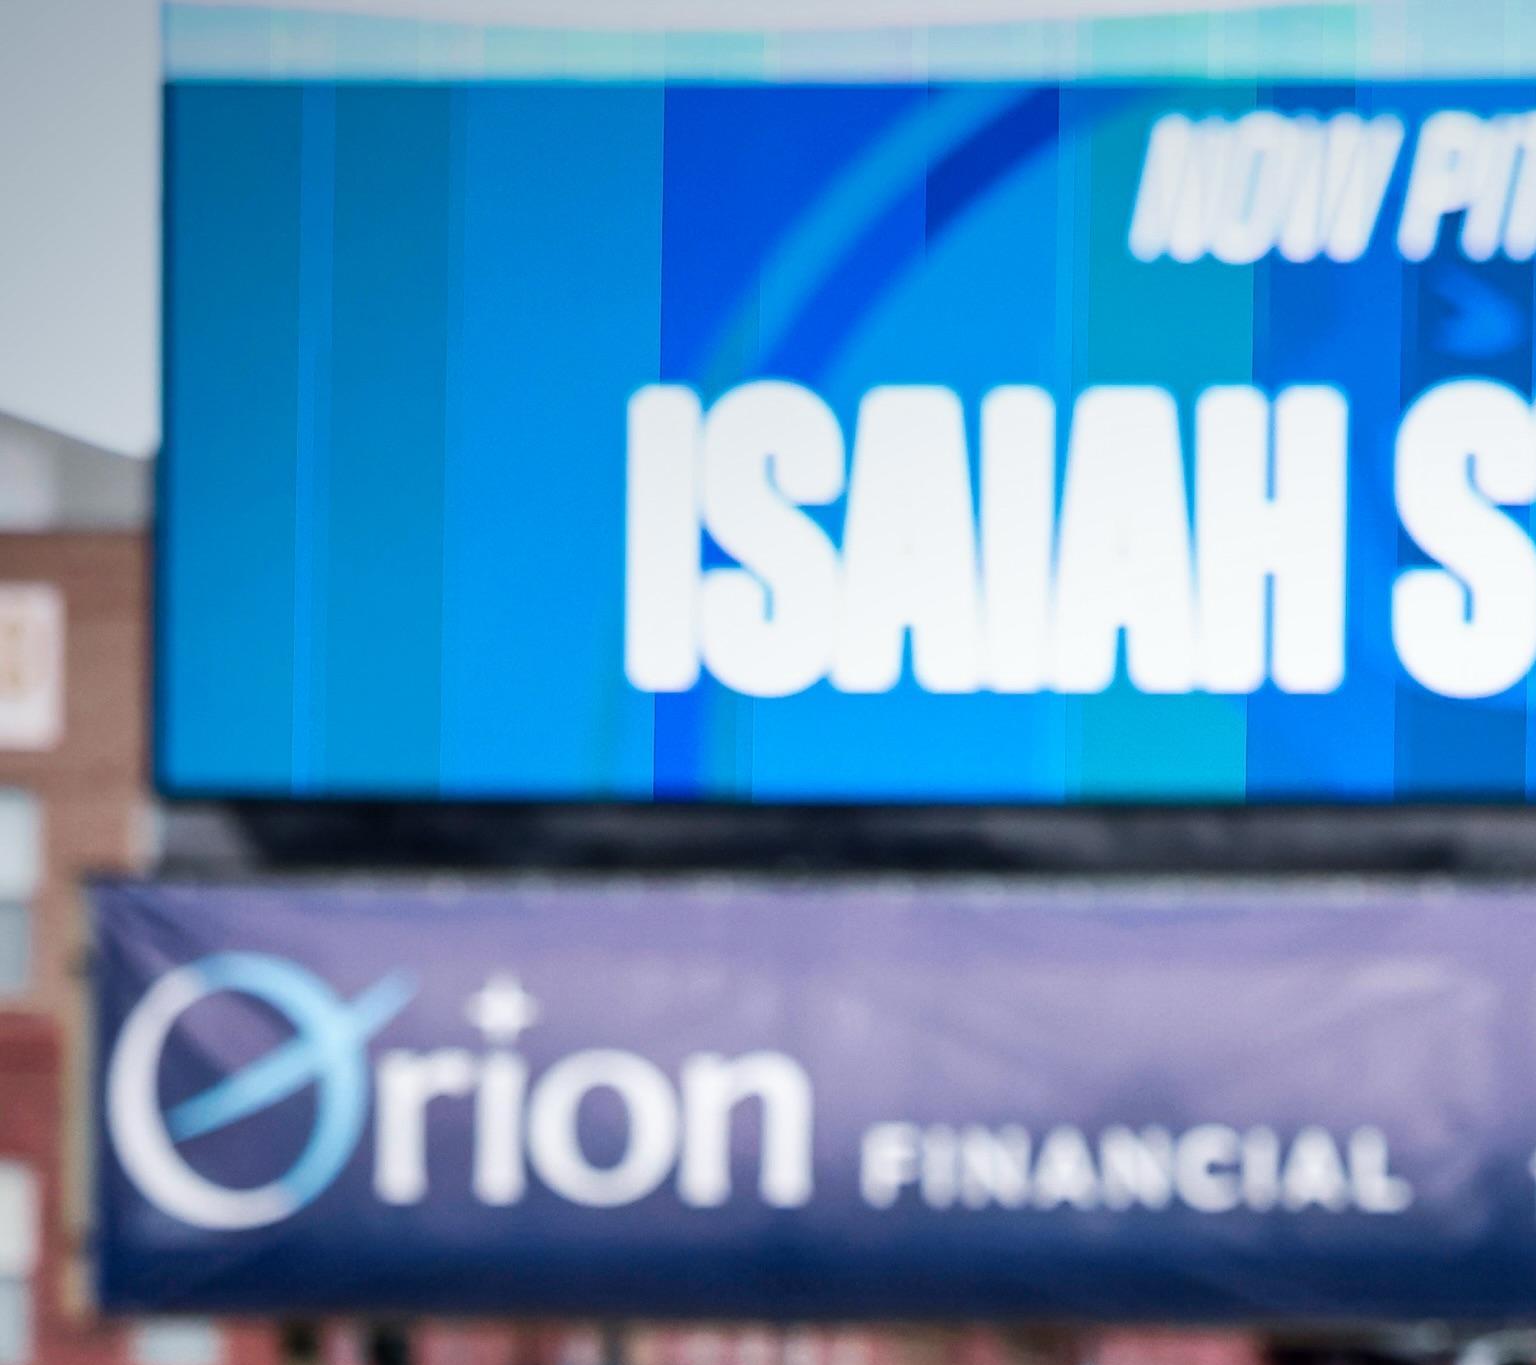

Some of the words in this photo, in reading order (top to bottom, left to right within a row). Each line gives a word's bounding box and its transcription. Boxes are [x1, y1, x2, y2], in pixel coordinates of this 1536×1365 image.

[1128, 110, 1402, 263] NOW
[624, 380, 1349, 697] ISAIAH
[106, 950, 816, 1232] Orion
[860, 1122, 1412, 1214] FINANCIAL
